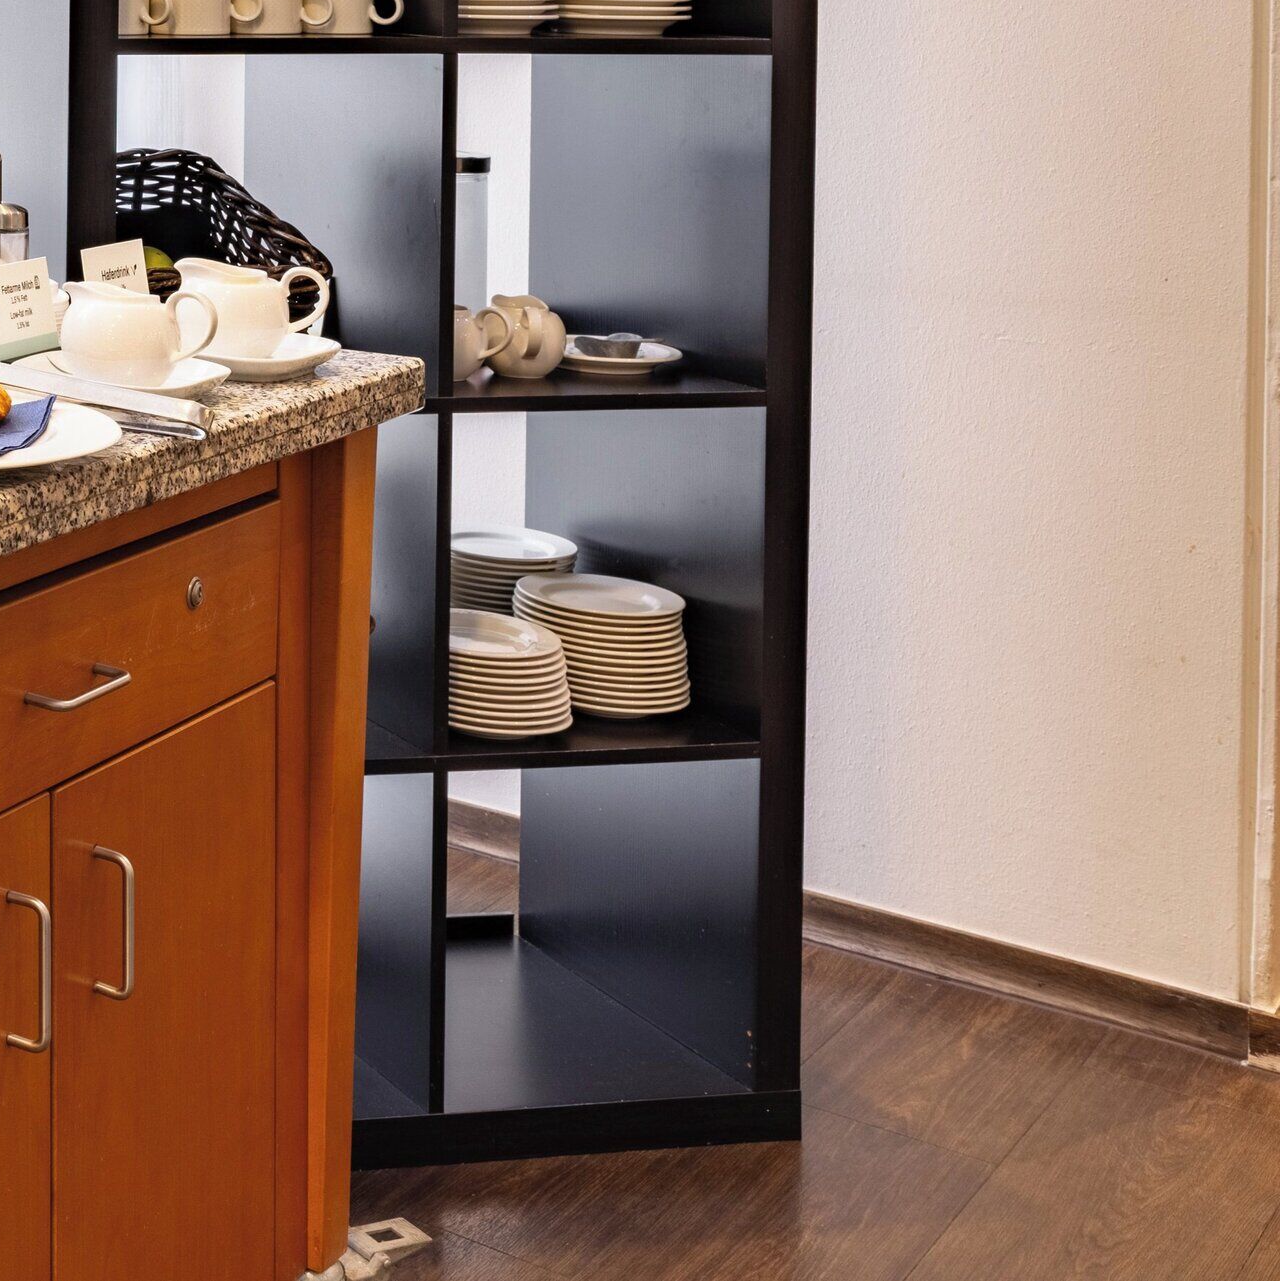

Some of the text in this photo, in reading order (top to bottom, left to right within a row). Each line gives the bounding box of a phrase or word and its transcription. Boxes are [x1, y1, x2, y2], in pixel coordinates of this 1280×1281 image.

[101, 265, 130, 281] Haferdrink
[1, 279, 33, 295] Fettarme Milch
[24, 307, 33, 317] milk
